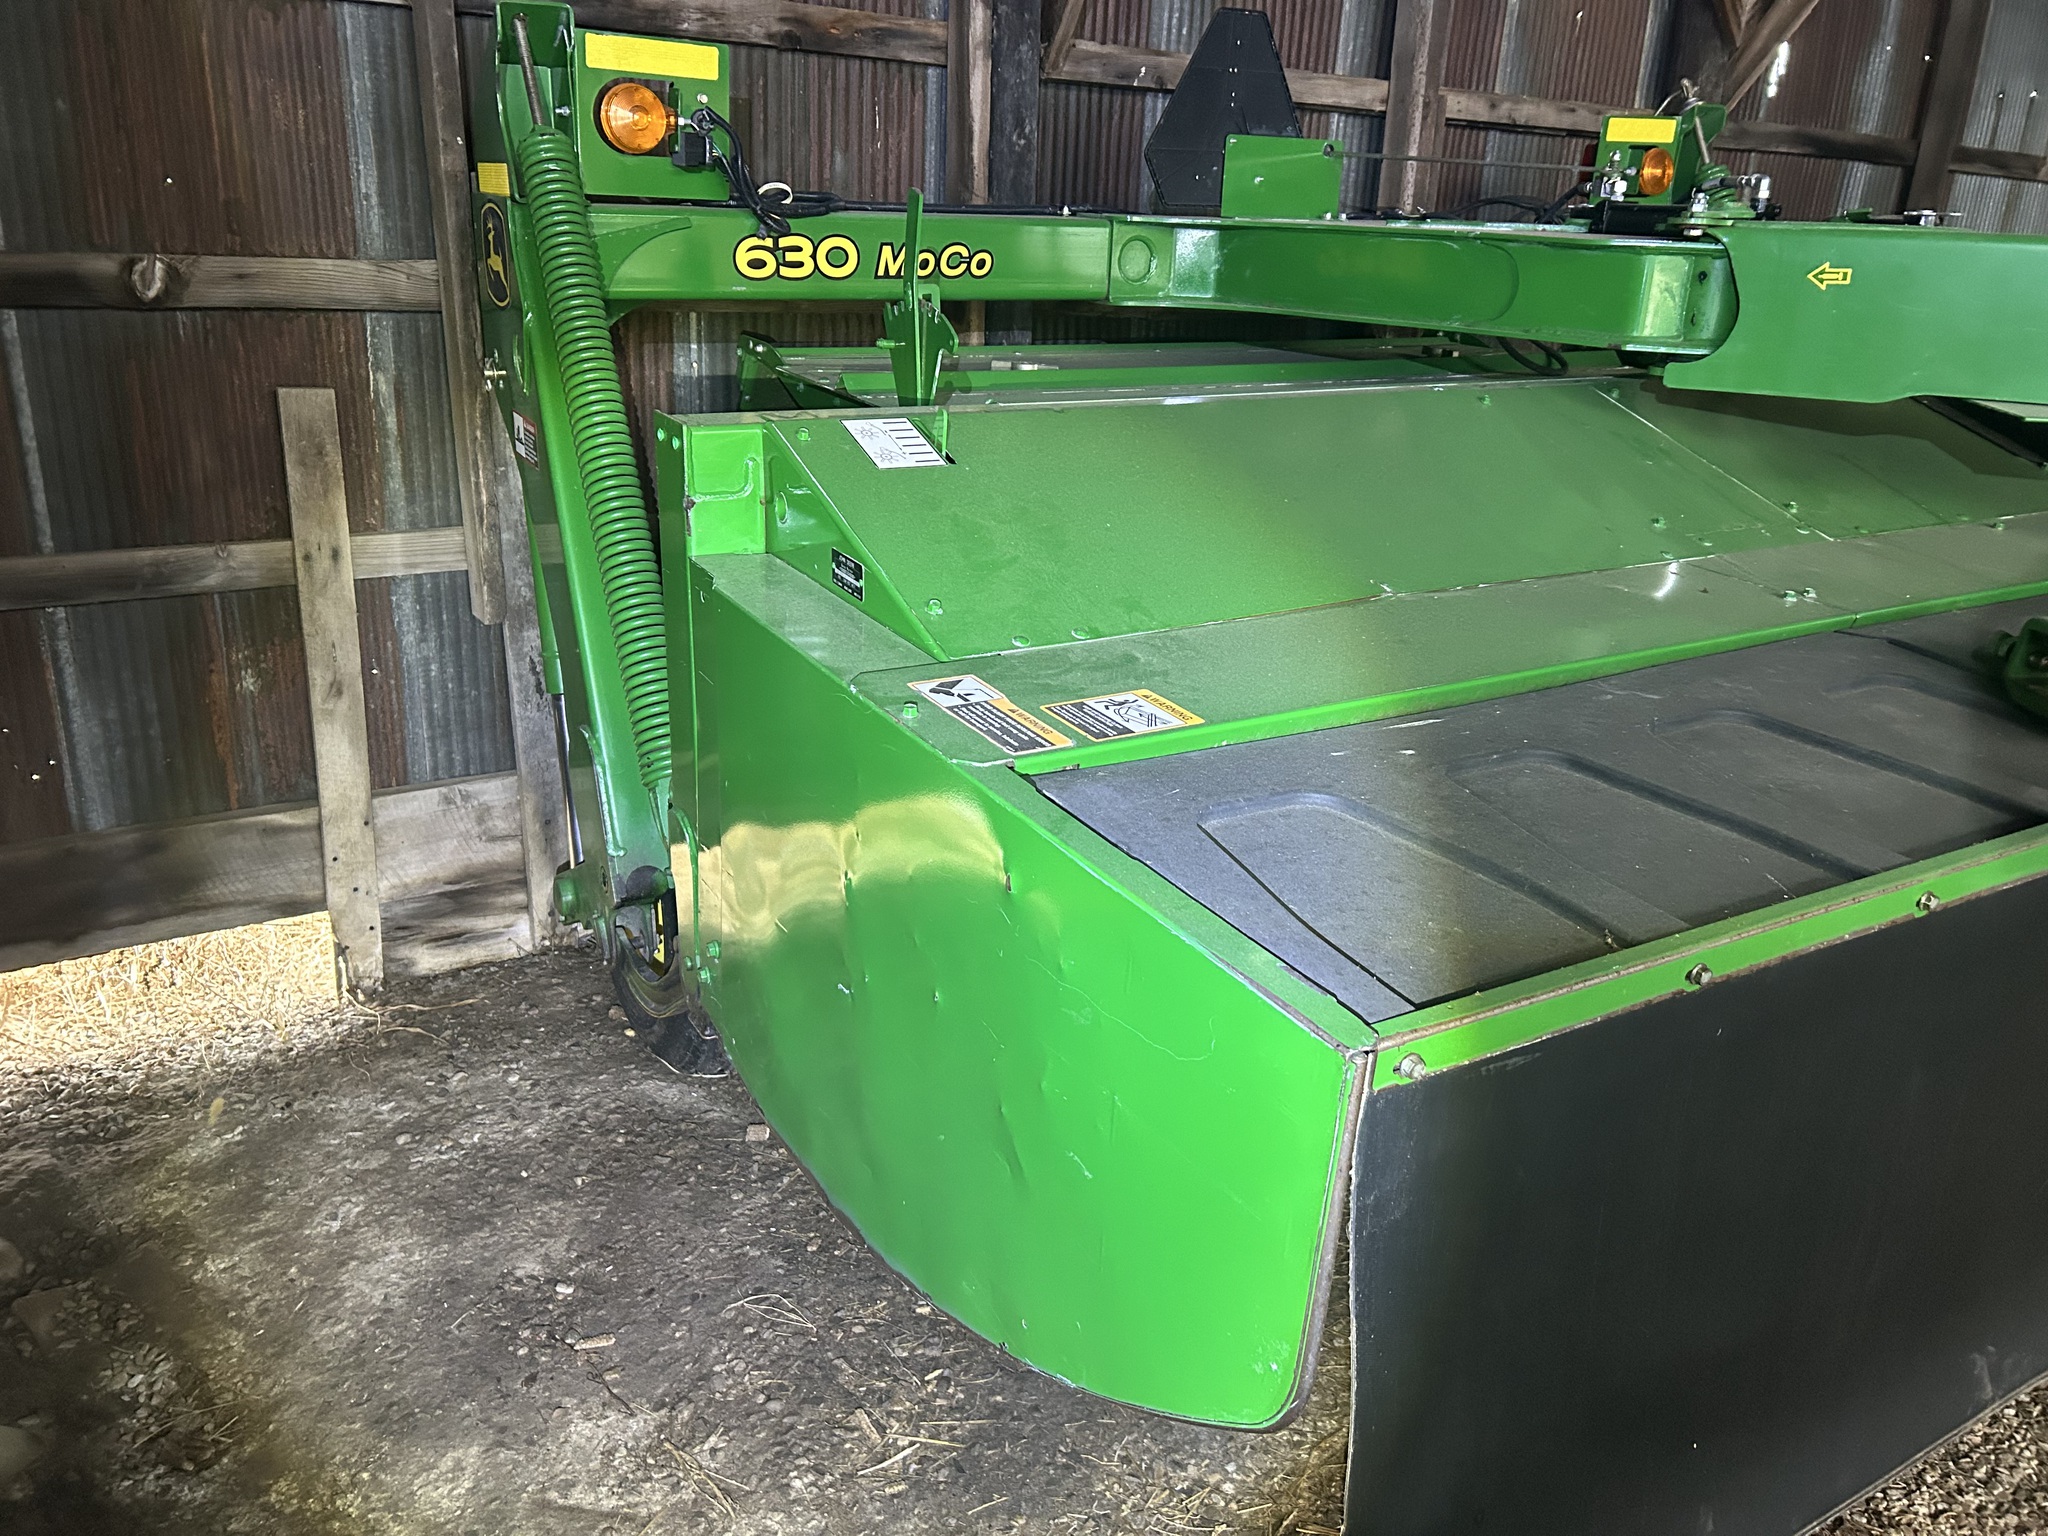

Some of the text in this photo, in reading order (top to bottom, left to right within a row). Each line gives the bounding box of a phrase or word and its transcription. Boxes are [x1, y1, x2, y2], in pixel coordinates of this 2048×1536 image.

[734, 234, 994, 281] 630 MoCo
[1015, 709, 1053, 735] WARNING
[1150, 697, 1193, 721] WARNING
